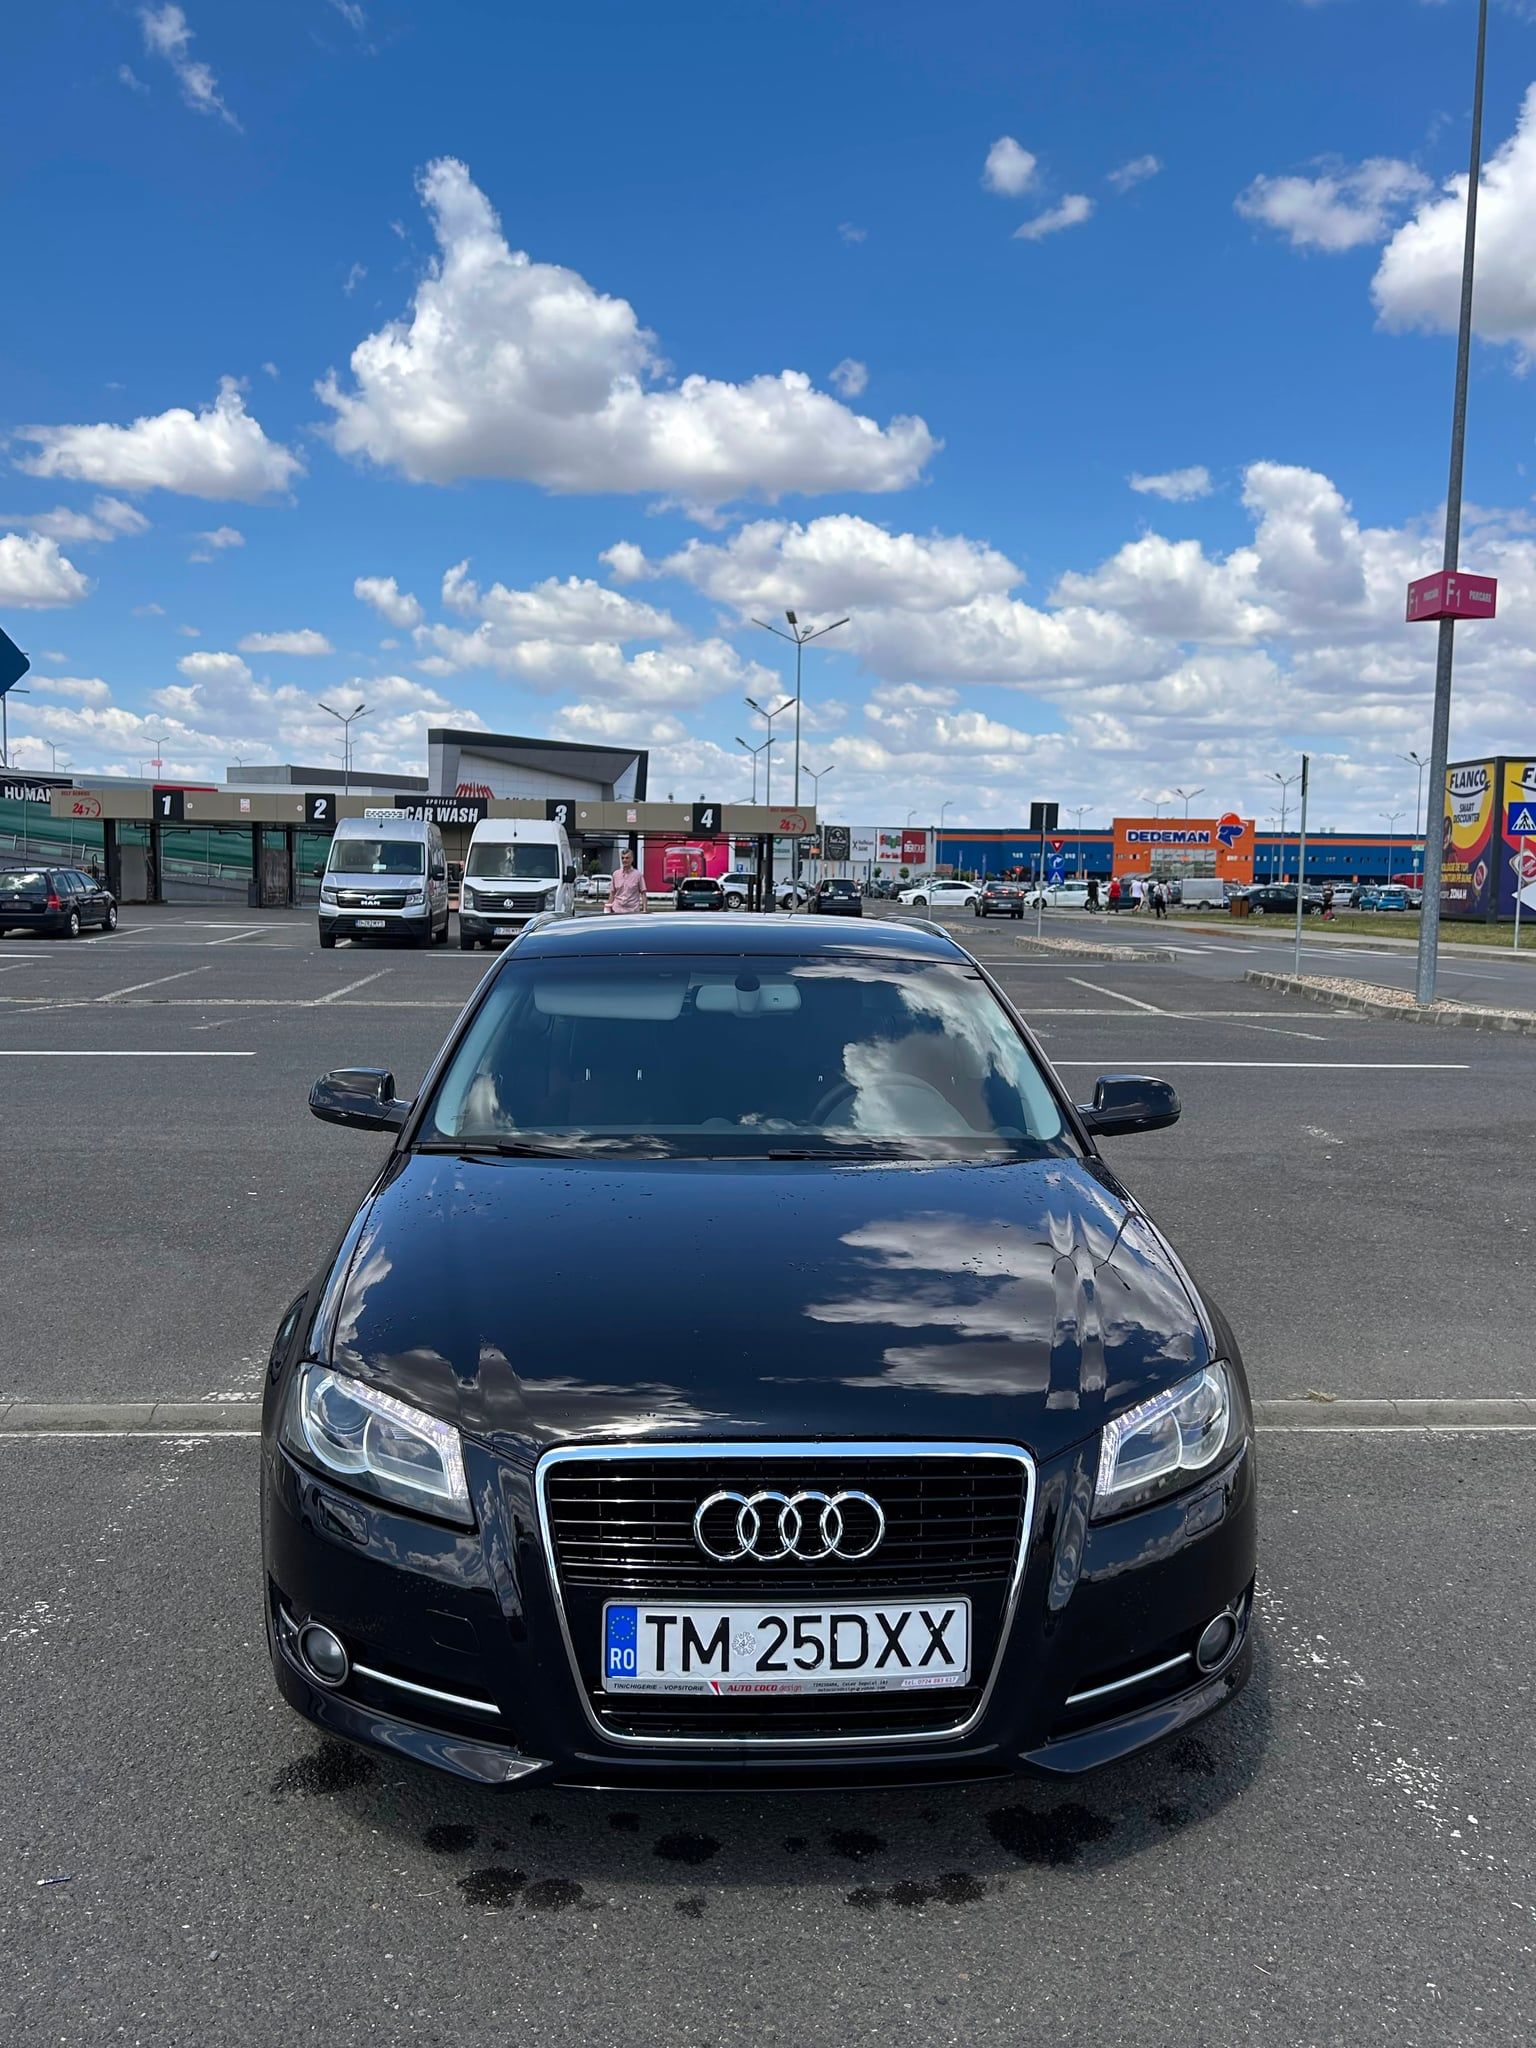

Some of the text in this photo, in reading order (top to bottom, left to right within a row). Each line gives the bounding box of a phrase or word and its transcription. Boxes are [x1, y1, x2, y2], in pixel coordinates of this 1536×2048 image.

[1446, 578, 1460, 607] F1
[1449, 769, 1487, 789] FLANCO
[162, 795, 171, 815] 1
[313, 799, 327, 819] 2
[406, 806, 479, 823] CAR WASH
[555, 804, 568, 824] 3
[1459, 803, 1475, 813] SMART
[700, 808, 713, 828] 4
[1453, 813, 1479, 823] DISCOUNTER
[1127, 830, 1211, 844] DEDEMAN
[645, 1609, 956, 1673] TM 25DXX
[610, 1648, 635, 1670] RO
[727, 1683, 802, 1693] AUTO COCO design
